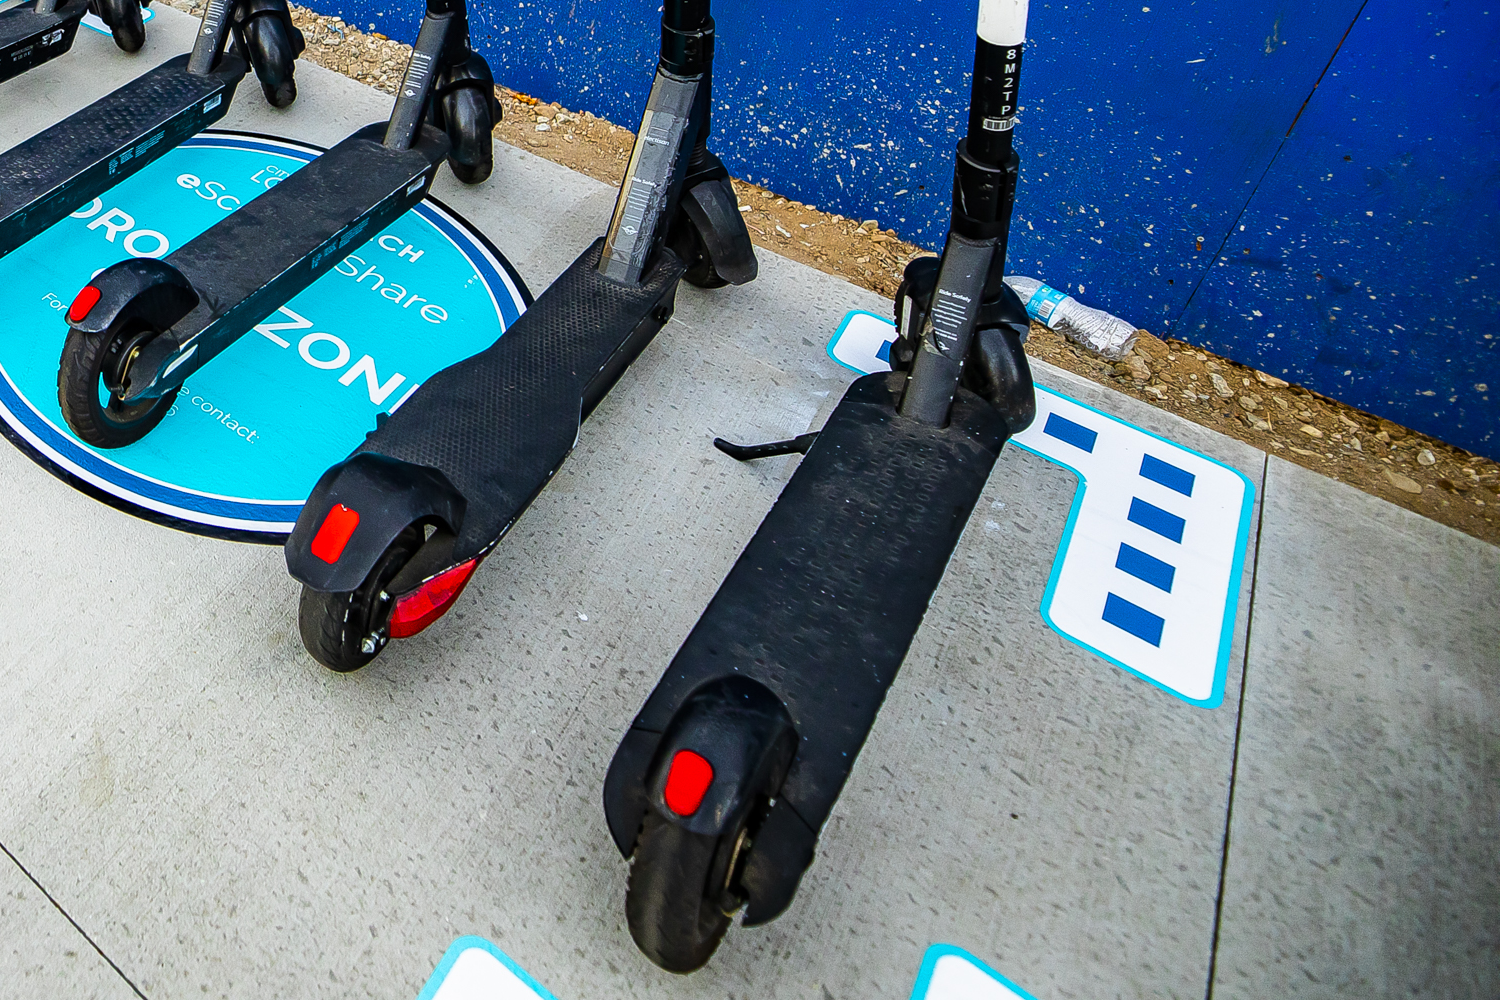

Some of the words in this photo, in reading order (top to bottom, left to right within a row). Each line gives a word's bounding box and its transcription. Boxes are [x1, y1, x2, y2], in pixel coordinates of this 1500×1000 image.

[1000, 48, 1017, 116] 8M2TP
[334, 254, 449, 325] Share
[253, 305, 420, 416] ZON
[191, 395, 260, 445] contact:
